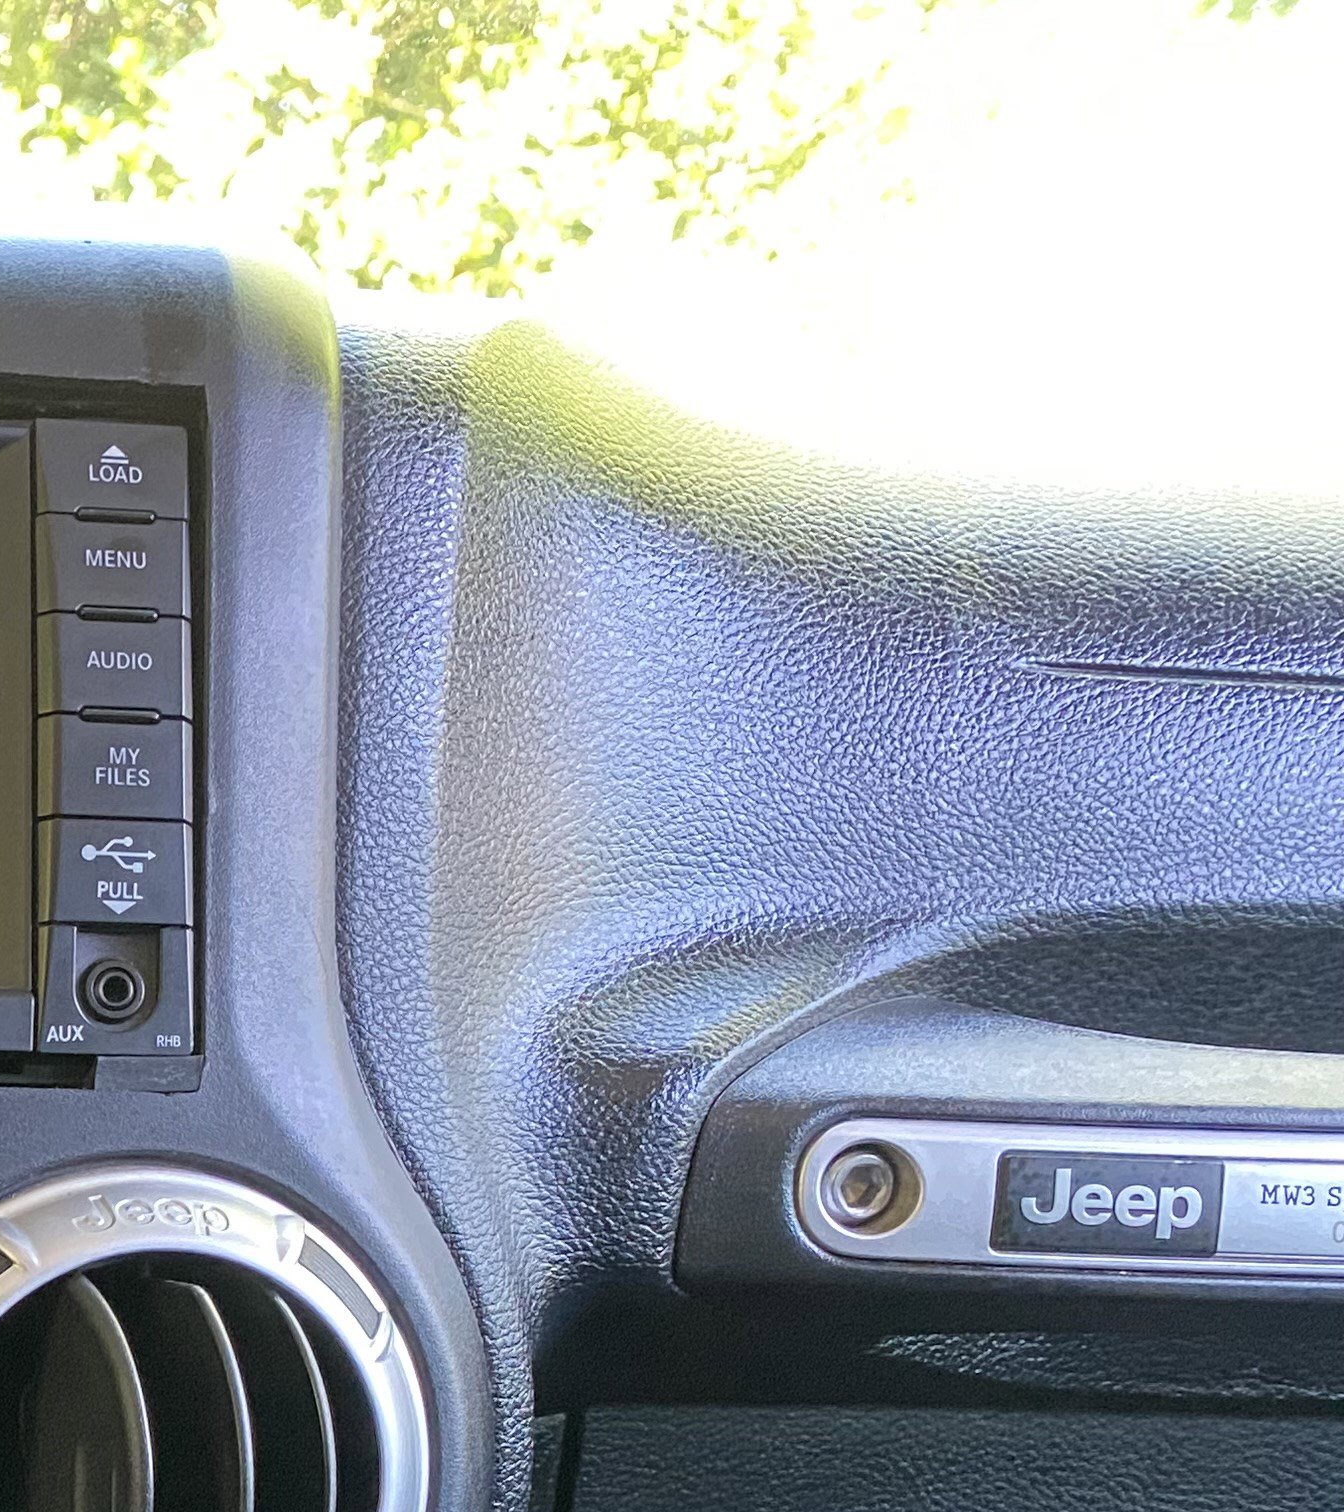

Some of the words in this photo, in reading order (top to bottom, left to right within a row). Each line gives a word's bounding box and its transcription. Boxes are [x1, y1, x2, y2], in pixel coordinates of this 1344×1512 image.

[88, 463, 143, 484] LOAD
[85, 548, 147, 570] MENU
[86, 650, 153, 671] AUDIO
[107, 746, 141, 767] MY
[95, 766, 151, 787] FILES
[96, 880, 144, 901] PULL
[46, 1024, 85, 1043] AUX
[156, 1034, 182, 1048] RHB
[1020, 1167, 1203, 1240] Jeep
[1259, 1183, 1316, 1206] MW3
[1327, 1186, 1344, 1213] S
[71, 1194, 230, 1236] Jeep
